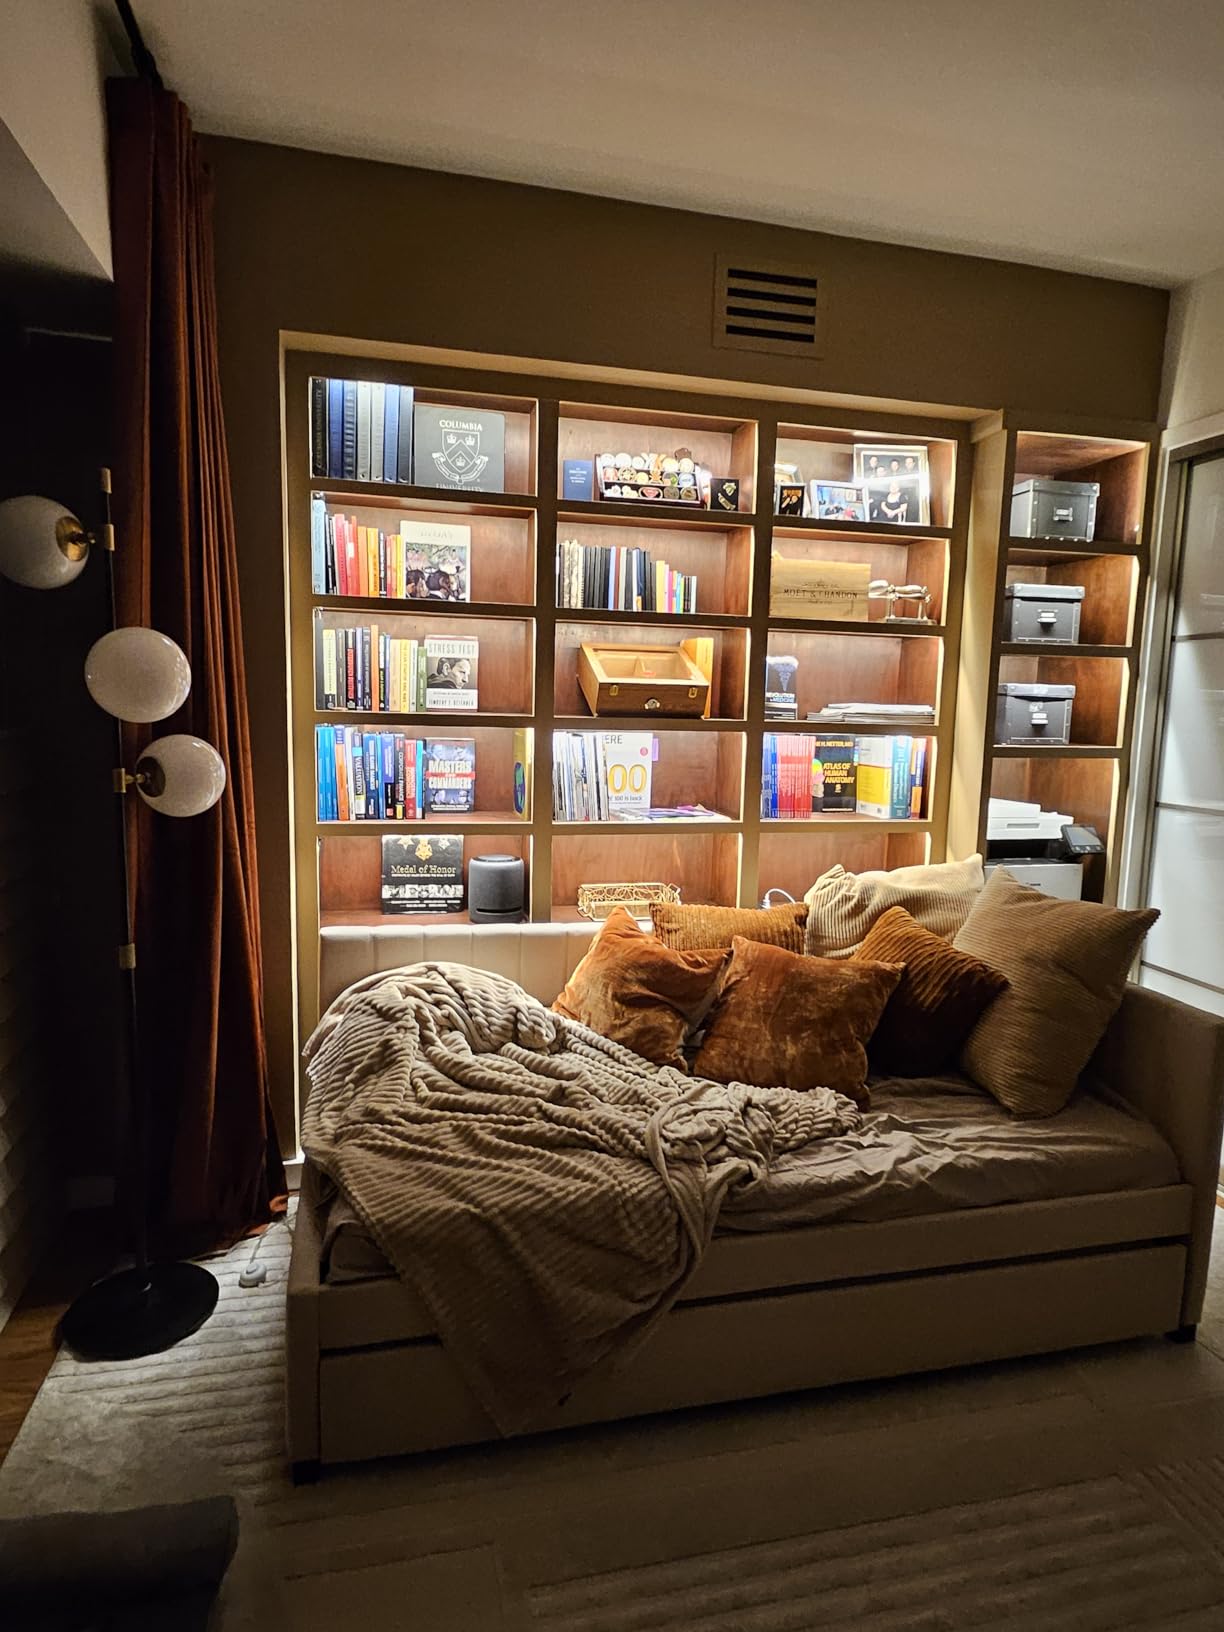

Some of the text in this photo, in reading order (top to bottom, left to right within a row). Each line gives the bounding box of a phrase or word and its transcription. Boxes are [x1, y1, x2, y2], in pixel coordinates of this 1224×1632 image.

[439, 419, 483, 431] COLUMBIA
[428, 642, 475, 655] STRESS TEST
[428, 759, 472, 774] MASTERS
[823, 762, 841, 770] ATLAS
[355, 756, 363, 795] VALUATION
[390, 864, 457, 874] Medal of Honor
